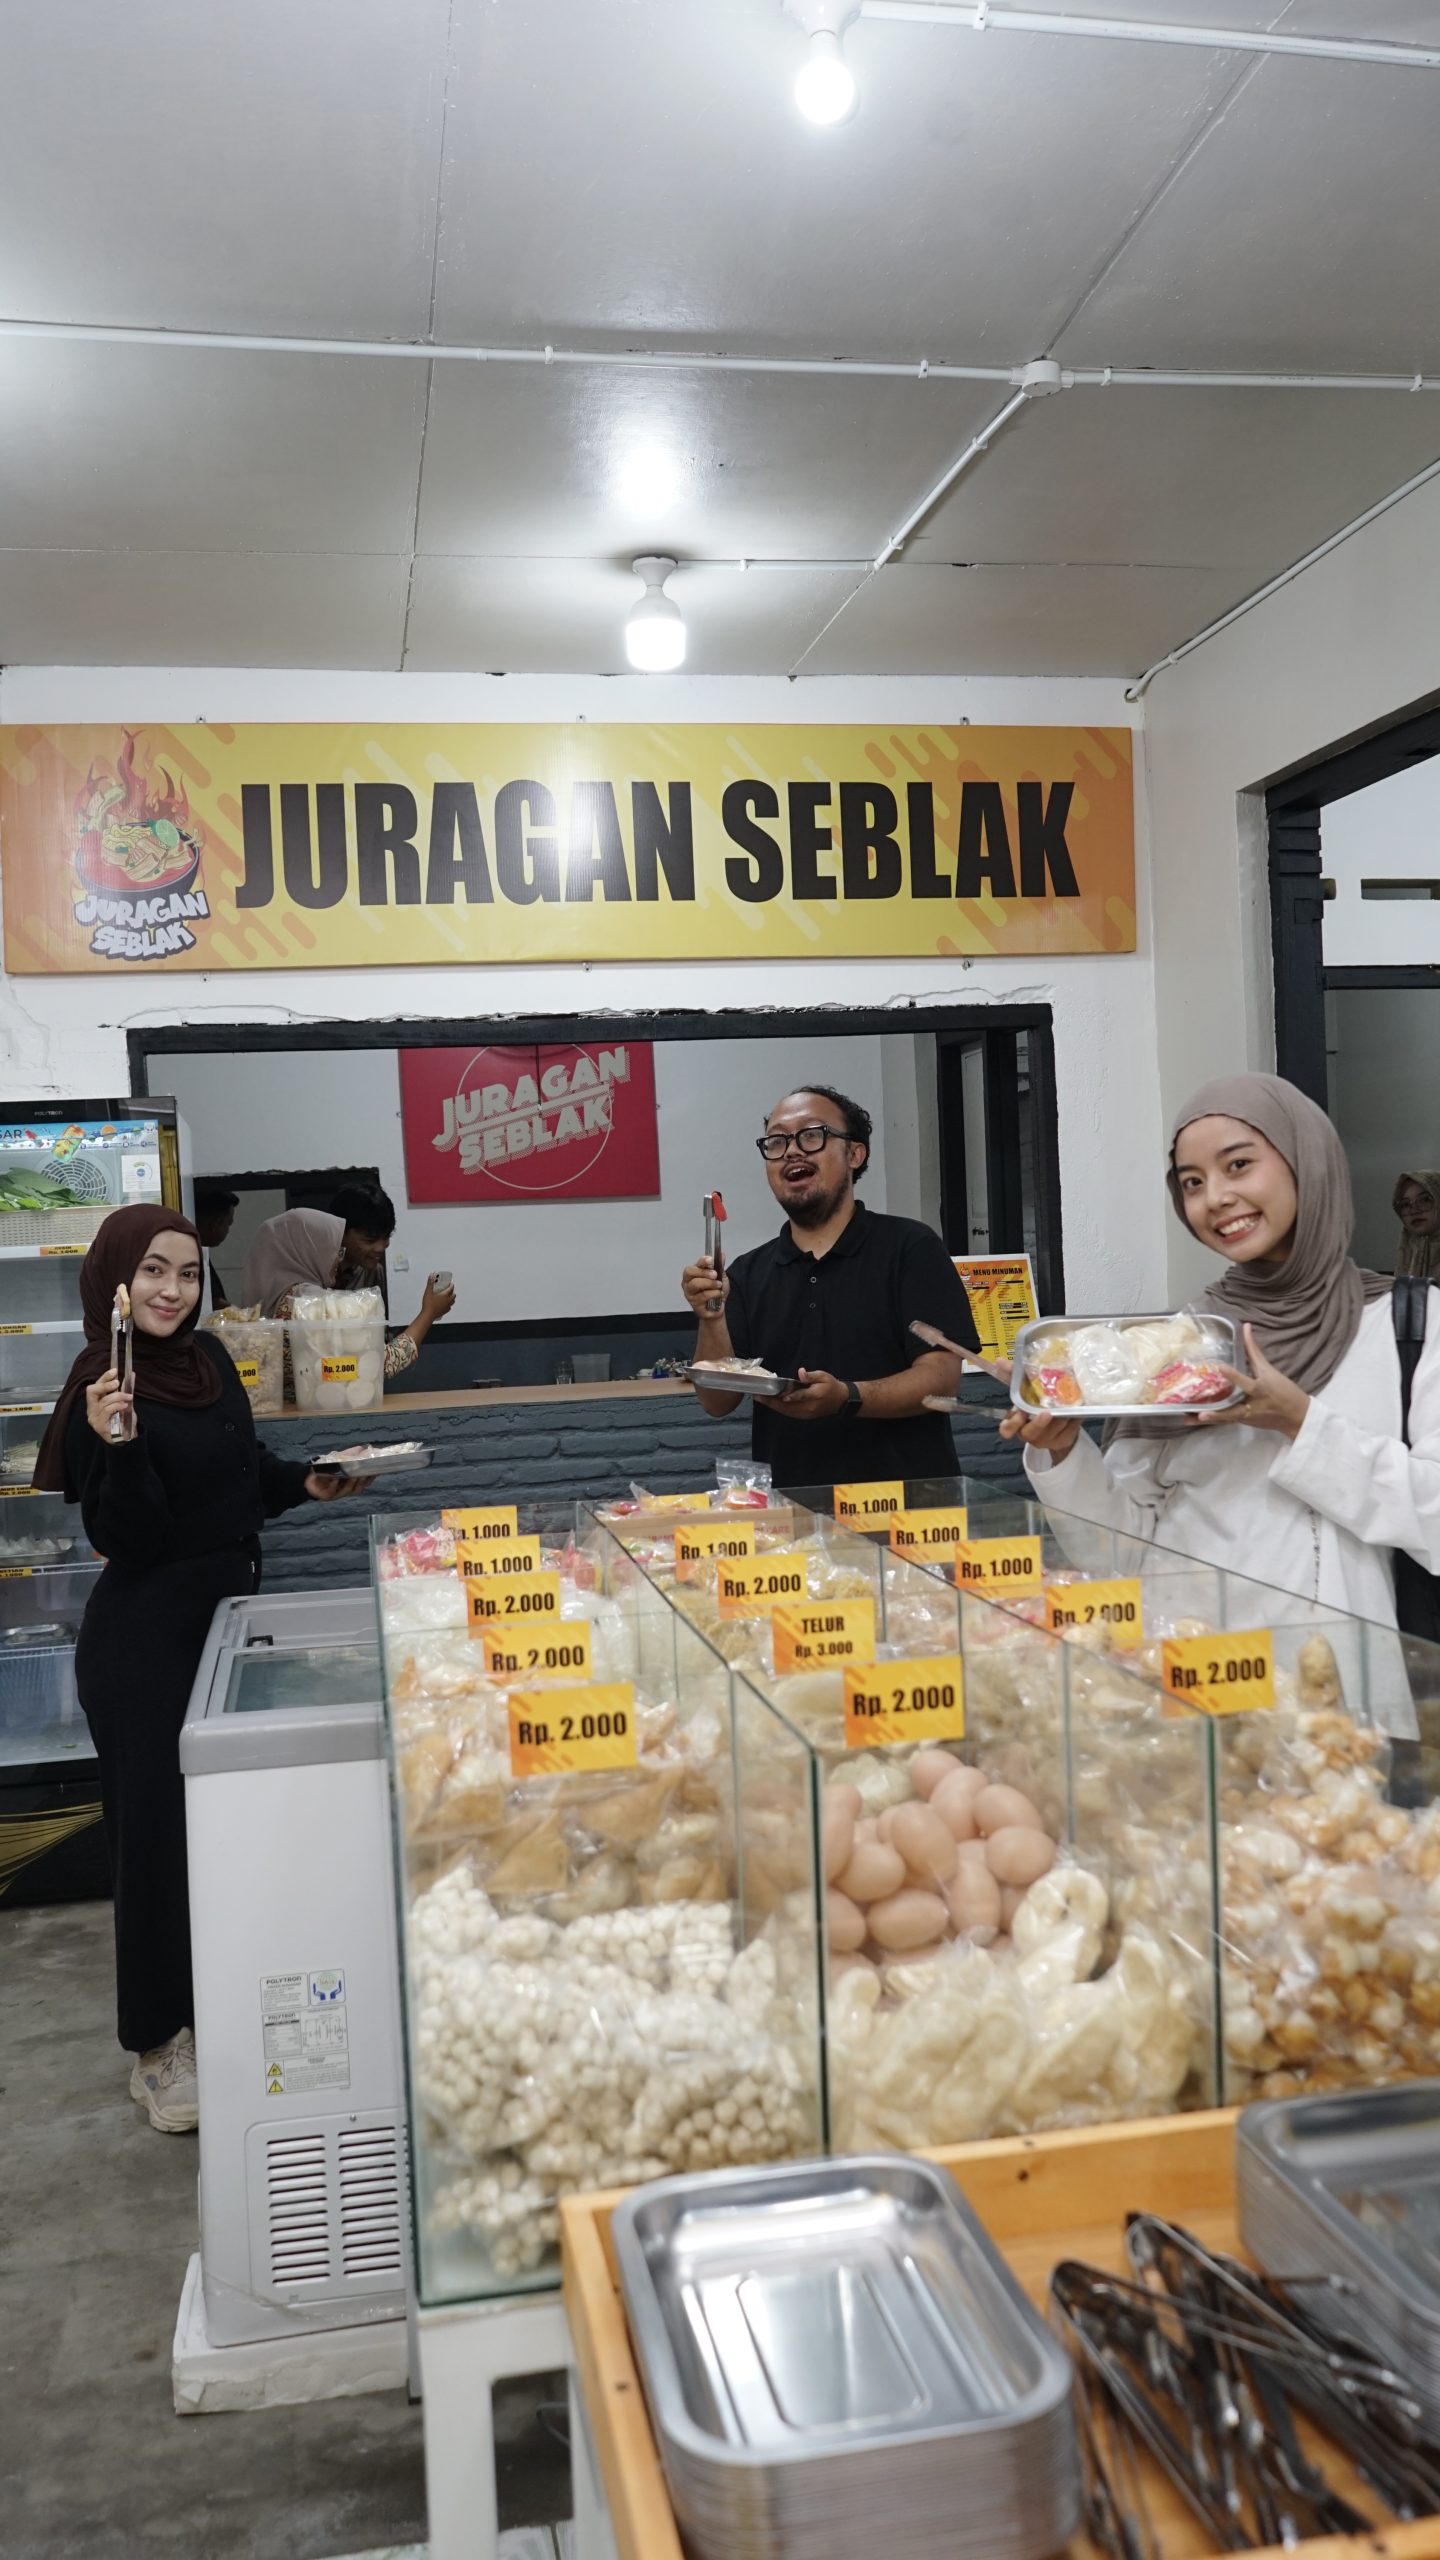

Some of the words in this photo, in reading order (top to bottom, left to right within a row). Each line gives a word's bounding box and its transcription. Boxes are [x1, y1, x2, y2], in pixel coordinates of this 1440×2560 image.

[235, 779, 696, 910] JURAGAN
[721, 779, 1081, 903] SEBLAK
[75, 891, 209, 928] JURAGAN
[91, 922, 196, 957] SEBLAK
[432, 1046, 629, 1150] JURAGAN
[459, 1096, 613, 1172] SEBLAK
[973, 1268, 991, 1276] MENU
[992, 1267, 1023, 1275] MINUMAN
[323, 1365, 334, 1373] Rp.
[335, 1364, 355, 1373] 2.000
[839, 1501, 861, 1516] Rp.
[862, 1498, 898, 1513] 1.000
[472, 1523, 510, 1540] 1.000
[896, 1530, 919, 1545] Rp.
[920, 1527, 960, 1543] 1.000
[680, 1545, 704, 1560] Rp.
[463, 1561, 488, 1576] Rp.
[490, 1555, 533, 1574] 1.000
[961, 1561, 986, 1579] Rp.
[989, 1557, 1033, 1576] 1.000
[724, 1579, 750, 1597] Rp.
[753, 1574, 801, 1595] 2.000
[473, 1598, 501, 1617] Rp.
[504, 1592, 555, 1614] 2.000
[801, 1616, 845, 1634] TELUR
[1052, 1608, 1080, 1628] Rp.
[491, 1652, 523, 1672] Rp.
[527, 1645, 585, 1668] 2.000
[795, 1644, 815, 1658] Rp.
[817, 1641, 853, 1656] 3.000
[1171, 1666, 1203, 1689] Rp.
[1207, 1657, 1266, 1684] 2.000
[853, 1692, 888, 1717] Rp.
[892, 1685, 955, 1713] 2.000
[518, 1720, 555, 1746] Rp.
[560, 1712, 628, 1741] 2.000
